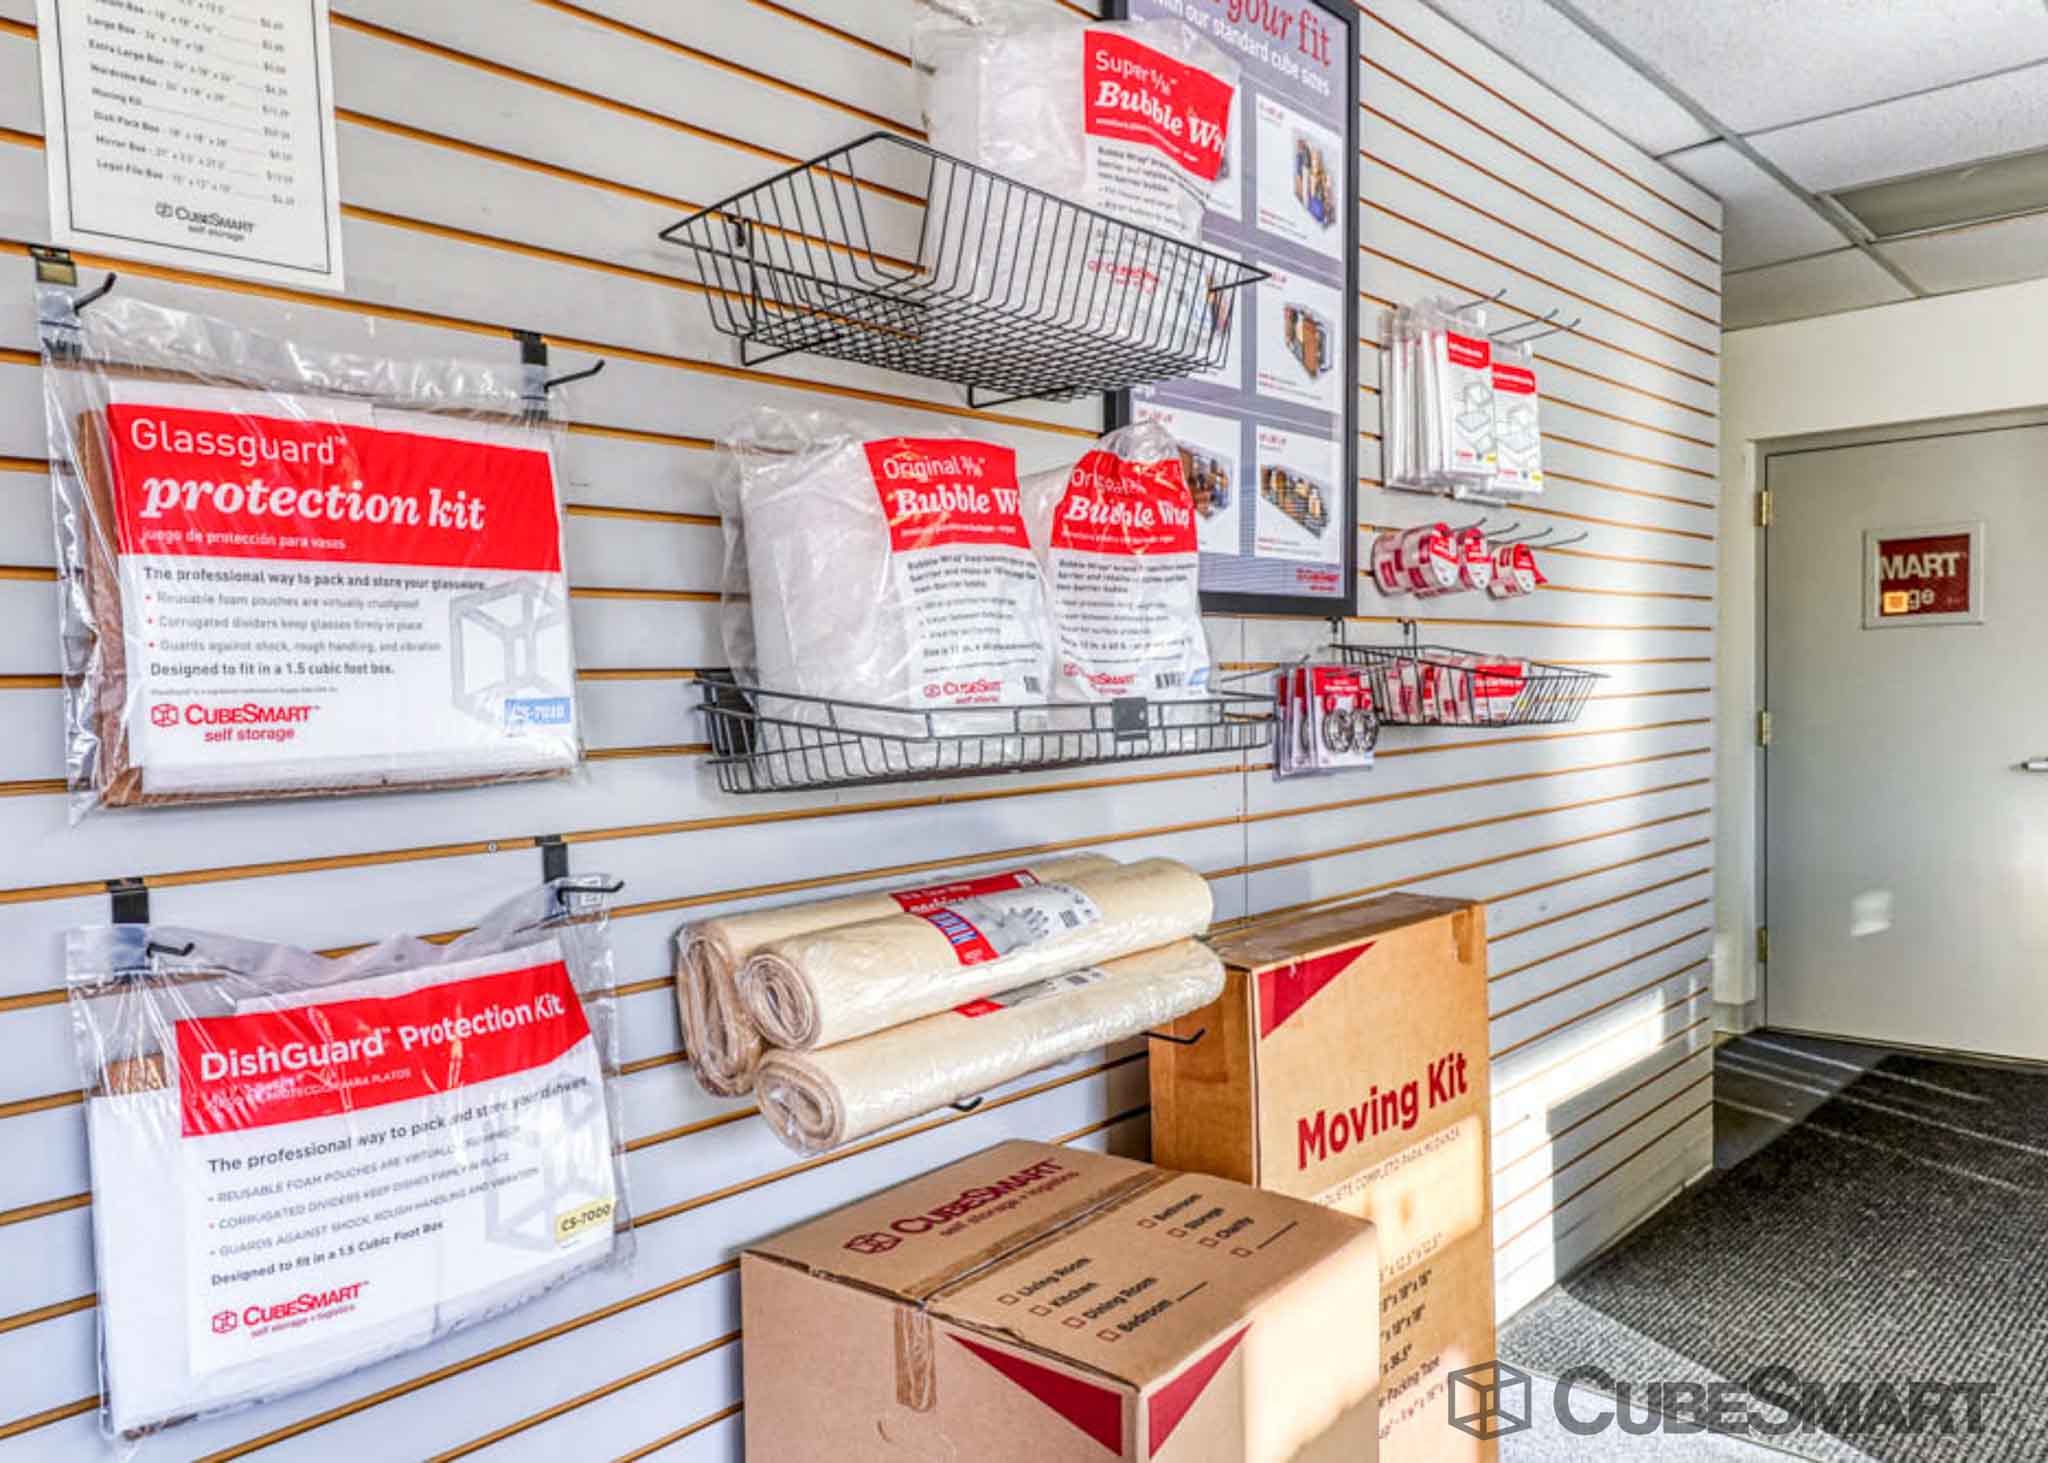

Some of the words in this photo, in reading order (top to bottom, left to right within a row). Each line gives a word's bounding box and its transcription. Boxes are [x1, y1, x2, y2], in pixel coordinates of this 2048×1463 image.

[1184, 4, 1209, 27] our
[1213, 17, 1269, 63] standard
[1227, 0, 1292, 41] your
[1298, 8, 1332, 68] fit
[1095, 49, 1150, 84] Super
[1094, 80, 1184, 137] Bubble
[175, 206, 255, 233] CUBESMART
[883, 455, 962, 482] Original
[139, 476, 420, 529] protection
[427, 488, 486, 531] kit
[895, 482, 991, 517] Bubble
[186, 528, 203, 543] de
[279, 534, 309, 549] para
[144, 567, 172, 581] The
[176, 568, 265, 585] professional
[268, 573, 296, 587] way
[298, 572, 312, 585] to
[314, 573, 344, 587] pack
[348, 574, 370, 587] and
[373, 575, 402, 588] store
[404, 577, 429, 592] your
[159, 616, 229, 631] Corrugated
[160, 639, 205, 652] Guards
[208, 640, 251, 654] against
[150, 661, 220, 679] Designed
[222, 662, 236, 675] to
[239, 661, 255, 675] fit
[258, 662, 271, 675] in
[274, 665, 282, 675] a
[286, 661, 306, 675] 1.5
[308, 661, 341, 675] cubic
[343, 661, 368, 675] foot
[184, 702, 312, 725] CUBESMART
[204, 727, 234, 742] self
[236, 727, 295, 743] storage
[399, 1004, 534, 1053] Protection
[534, 992, 565, 1021] Kit
[1297, 1079, 1421, 1171] Moving
[1426, 1051, 1468, 1110] Kit
[208, 1158, 242, 1174] The
[247, 1136, 352, 1171] professional
[358, 1130, 387, 1147] way
[391, 1126, 407, 1140] to
[411, 1116, 447, 1137] pack
[216, 1181, 284, 1203] REUSABLE
[286, 1174, 323, 1192] FOAM
[324, 1163, 378, 1182] POUCHES
[890, 1157, 1064, 1234] CUBESMART
[218, 1204, 306, 1230] CORRUGATED
[308, 1191, 361, 1213] DIVIDERS
[561, 1203, 611, 1232] CS-7000
[939, 1219, 969, 1236] self
[967, 1198, 1021, 1225] storage
[211, 1263, 275, 1286] Designed
[279, 1260, 293, 1273] to
[295, 1253, 311, 1268] fit
[312, 1252, 326, 1265] in
[327, 1250, 337, 1261] a
[358, 1237, 391, 1254] Cubic
[393, 1225, 420, 1242] Foot
[219, 1233, 273, 1256] GUARDS
[275, 1224, 329, 1246] AGAINST
[1017, 1275, 1061, 1297] Living
[1053, 1256, 1093, 1277] Room
[1049, 1281, 1100, 1308] Kitchen
[242, 1281, 361, 1327] CUBESMART
[1081, 1294, 1129, 1320] Dining
[1119, 1276, 1160, 1298] Room
[1115, 1297, 1175, 1333] Bedroom
